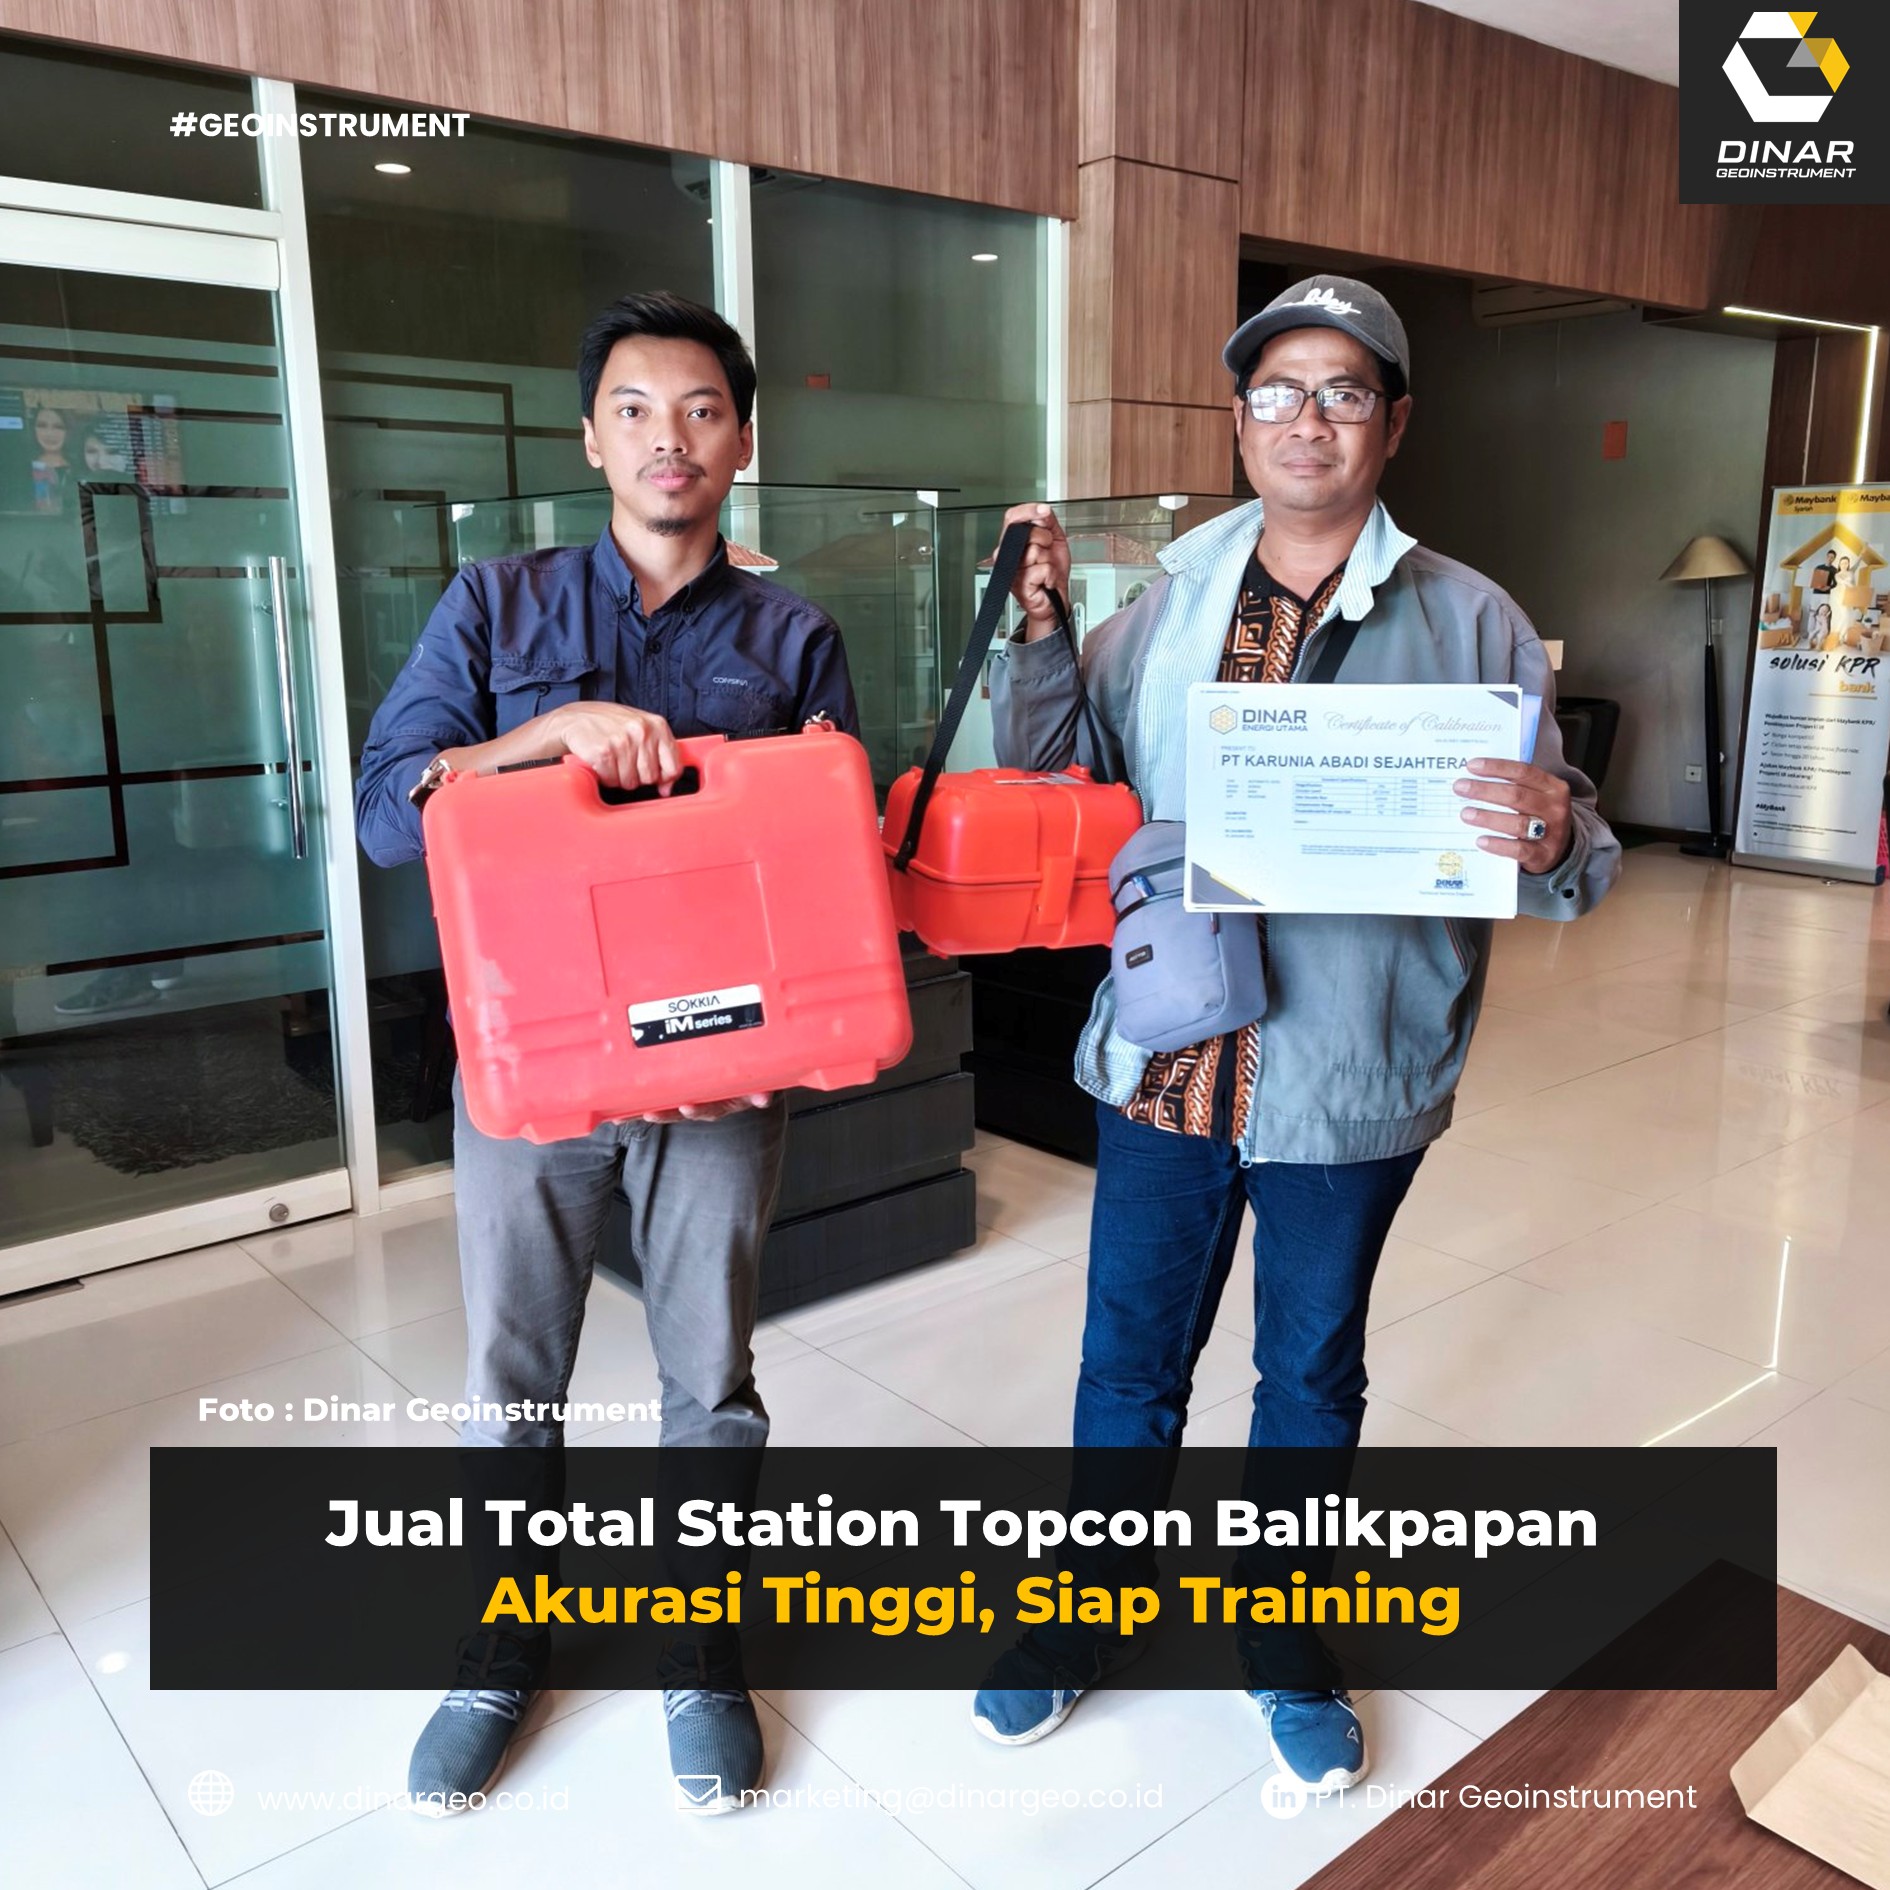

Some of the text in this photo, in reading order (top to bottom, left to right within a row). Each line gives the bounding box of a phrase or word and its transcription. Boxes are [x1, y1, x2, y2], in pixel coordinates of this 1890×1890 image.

[1794, 494, 1837, 505] Maybank
[1769, 652, 1880, 678] solusi KPR
[1839, 681, 1875, 693] bank
[1242, 709, 1307, 724] DINAR
[1323, 711, 1397, 735] Certificate
[1416, 711, 1502, 732] Calibration
[1242, 724, 1308, 732] ENERGI UTAMA
[1221, 754, 1468, 770] PT KARUNIA ABADI SEJAHTERA
[668, 995, 721, 1013] SOKKIA
[694, 1013, 733, 1030] series
